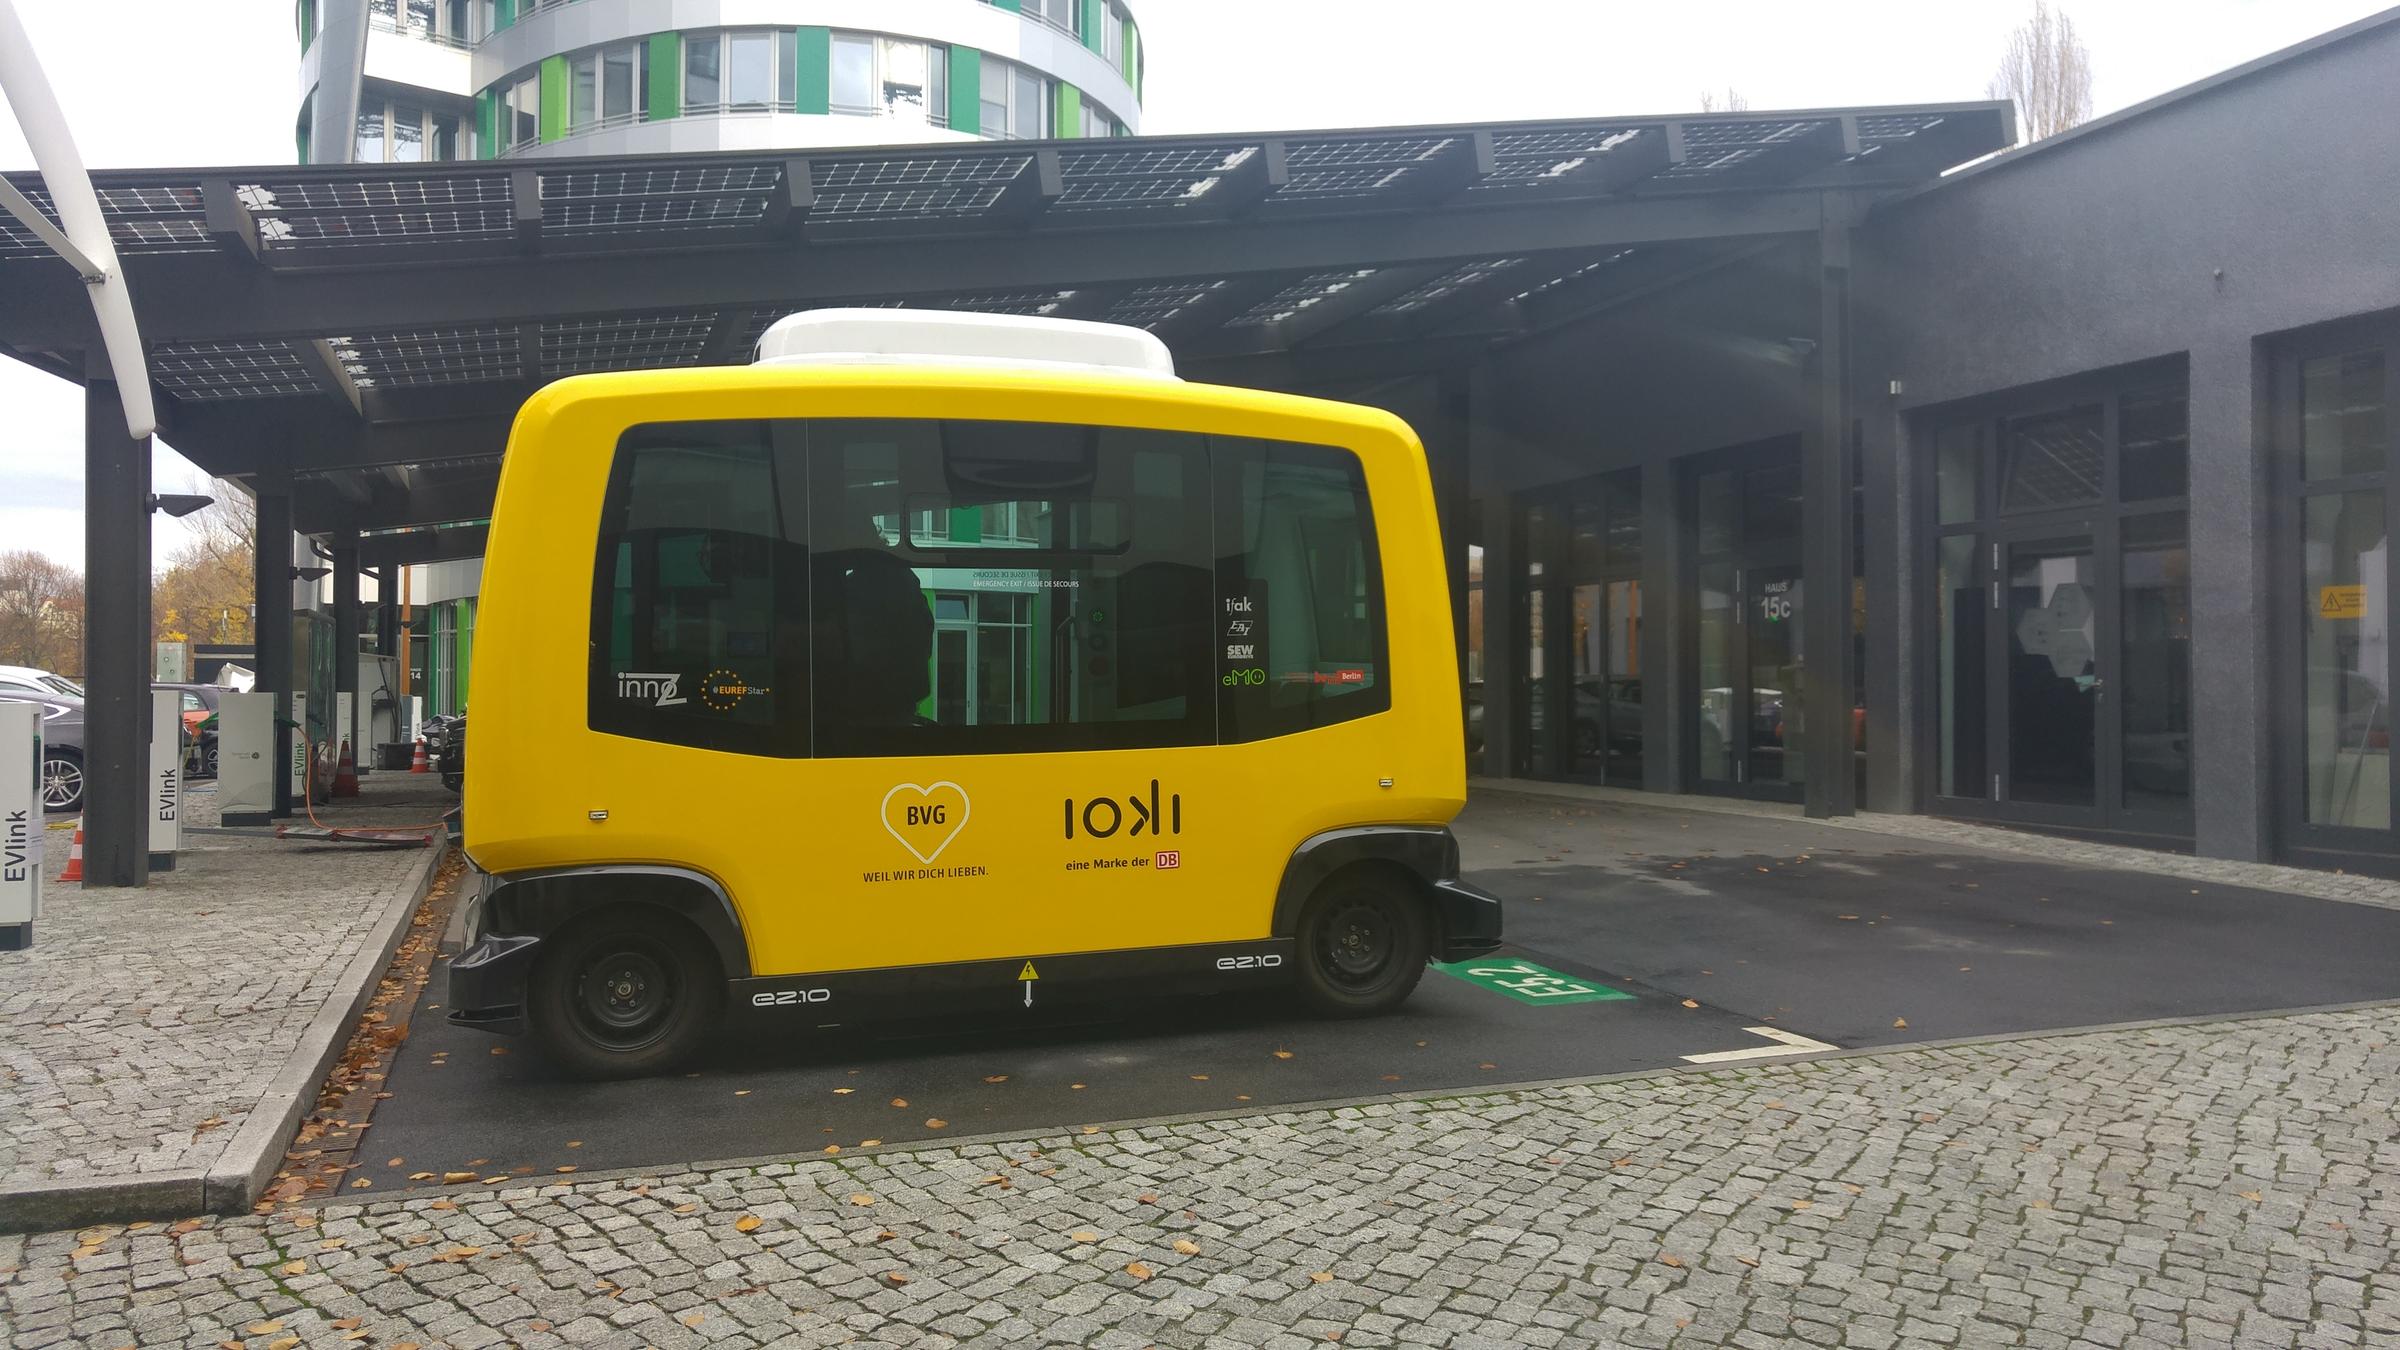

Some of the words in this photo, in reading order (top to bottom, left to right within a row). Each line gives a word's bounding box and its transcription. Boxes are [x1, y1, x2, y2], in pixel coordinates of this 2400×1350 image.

[973, 580, 1009, 588] EMERGENCY
[1053, 580, 1080, 588] SECOURS
[1764, 582, 1788, 593] HAUS
[1226, 597, 1252, 616] ifak
[1227, 645, 1254, 655] SEW
[410, 672, 421, 680] 14
[160, 769, 176, 821] EVlink
[907, 805, 946, 826] BVG
[4, 810, 27, 882] EVlink
[1066, 860, 1090, 870] eine
[1093, 858, 1128, 869] Marke
[1131, 857, 1150, 867] der
[1157, 852, 1179, 868] DB
[863, 872, 891, 883] WEIL
[893, 870, 915, 880] WIR
[918, 868, 945, 879] DICH
[948, 866, 989, 878] LIEBEN.
